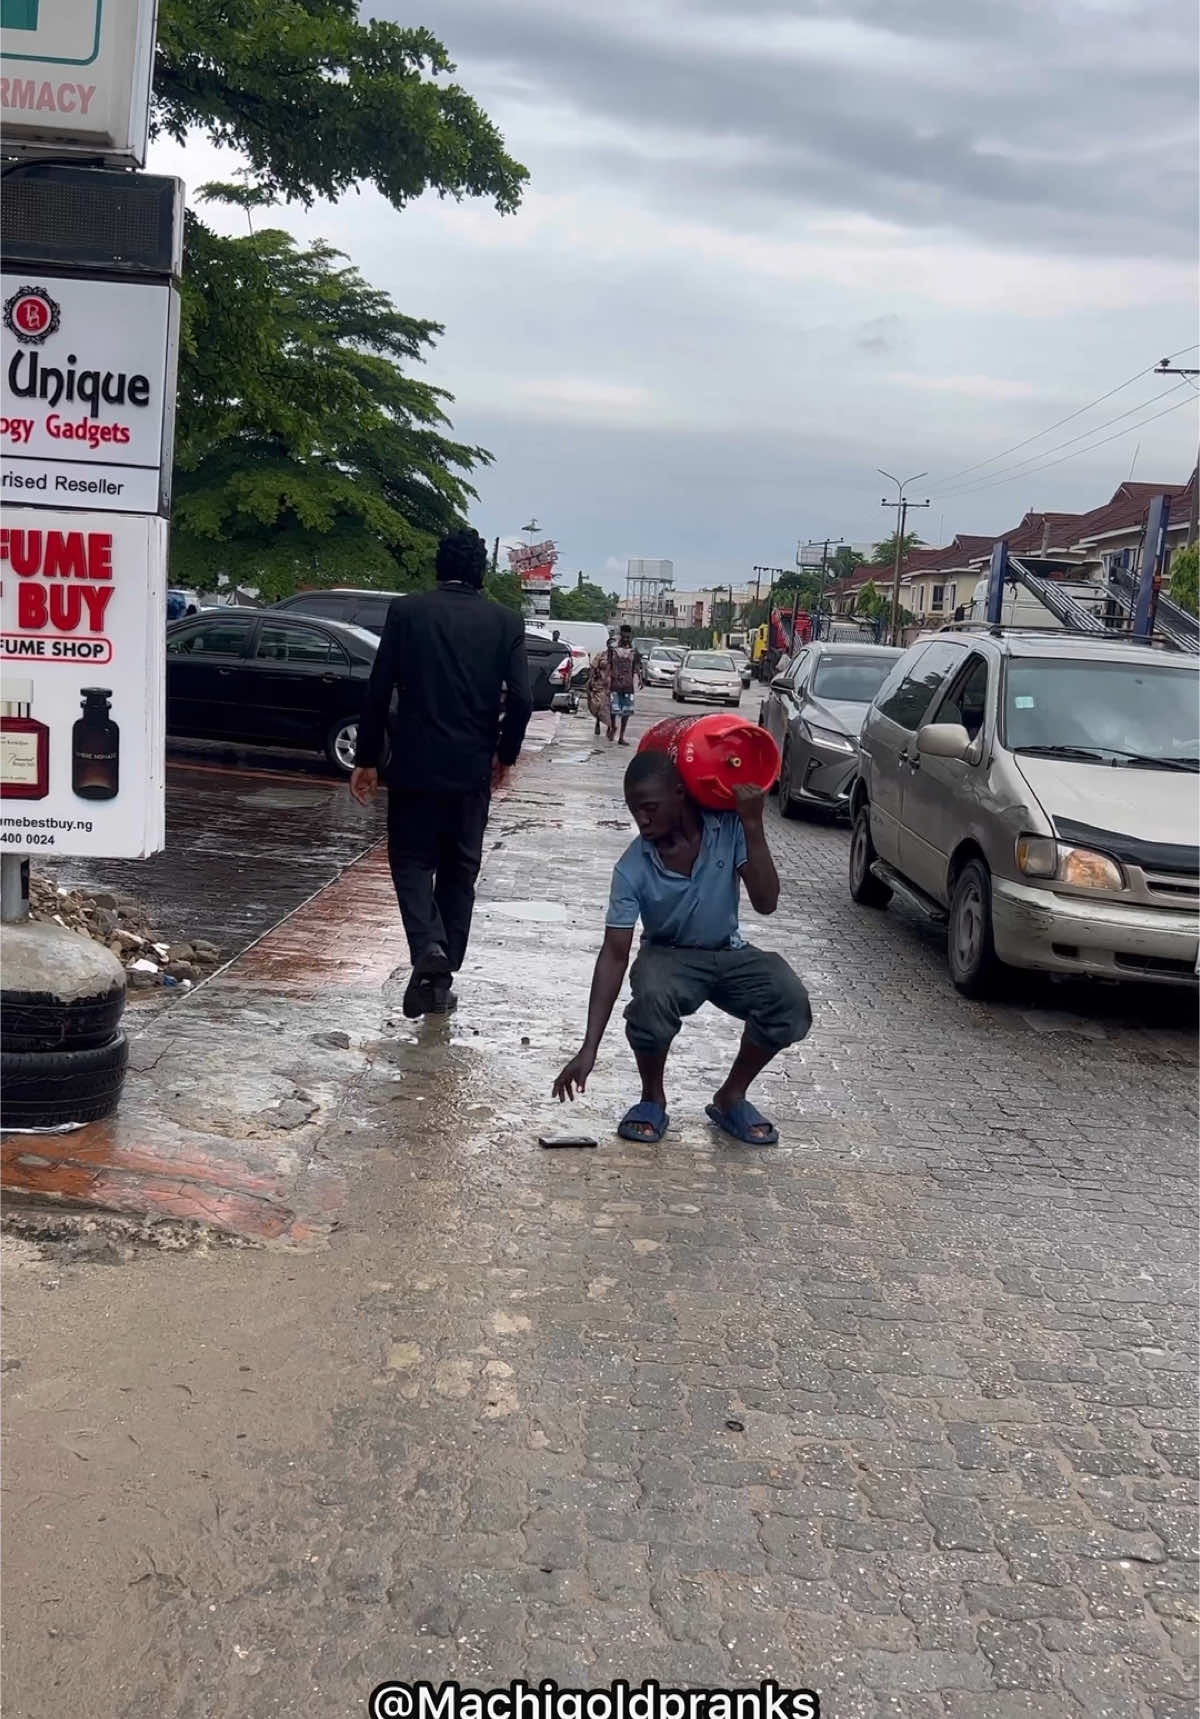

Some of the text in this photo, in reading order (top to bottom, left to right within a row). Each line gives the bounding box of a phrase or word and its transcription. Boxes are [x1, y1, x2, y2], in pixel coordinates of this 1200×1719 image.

[0, 78, 96, 114] RMACY
[8, 350, 150, 418] Unique
[0, 413, 130, 449] ogy Gadgets
[2, 470, 125, 496] rised Reseller
[18, 582, 116, 632] BUY
[52, 641, 104, 658] SHOP
[0, 833, 55, 845] 400 0024
